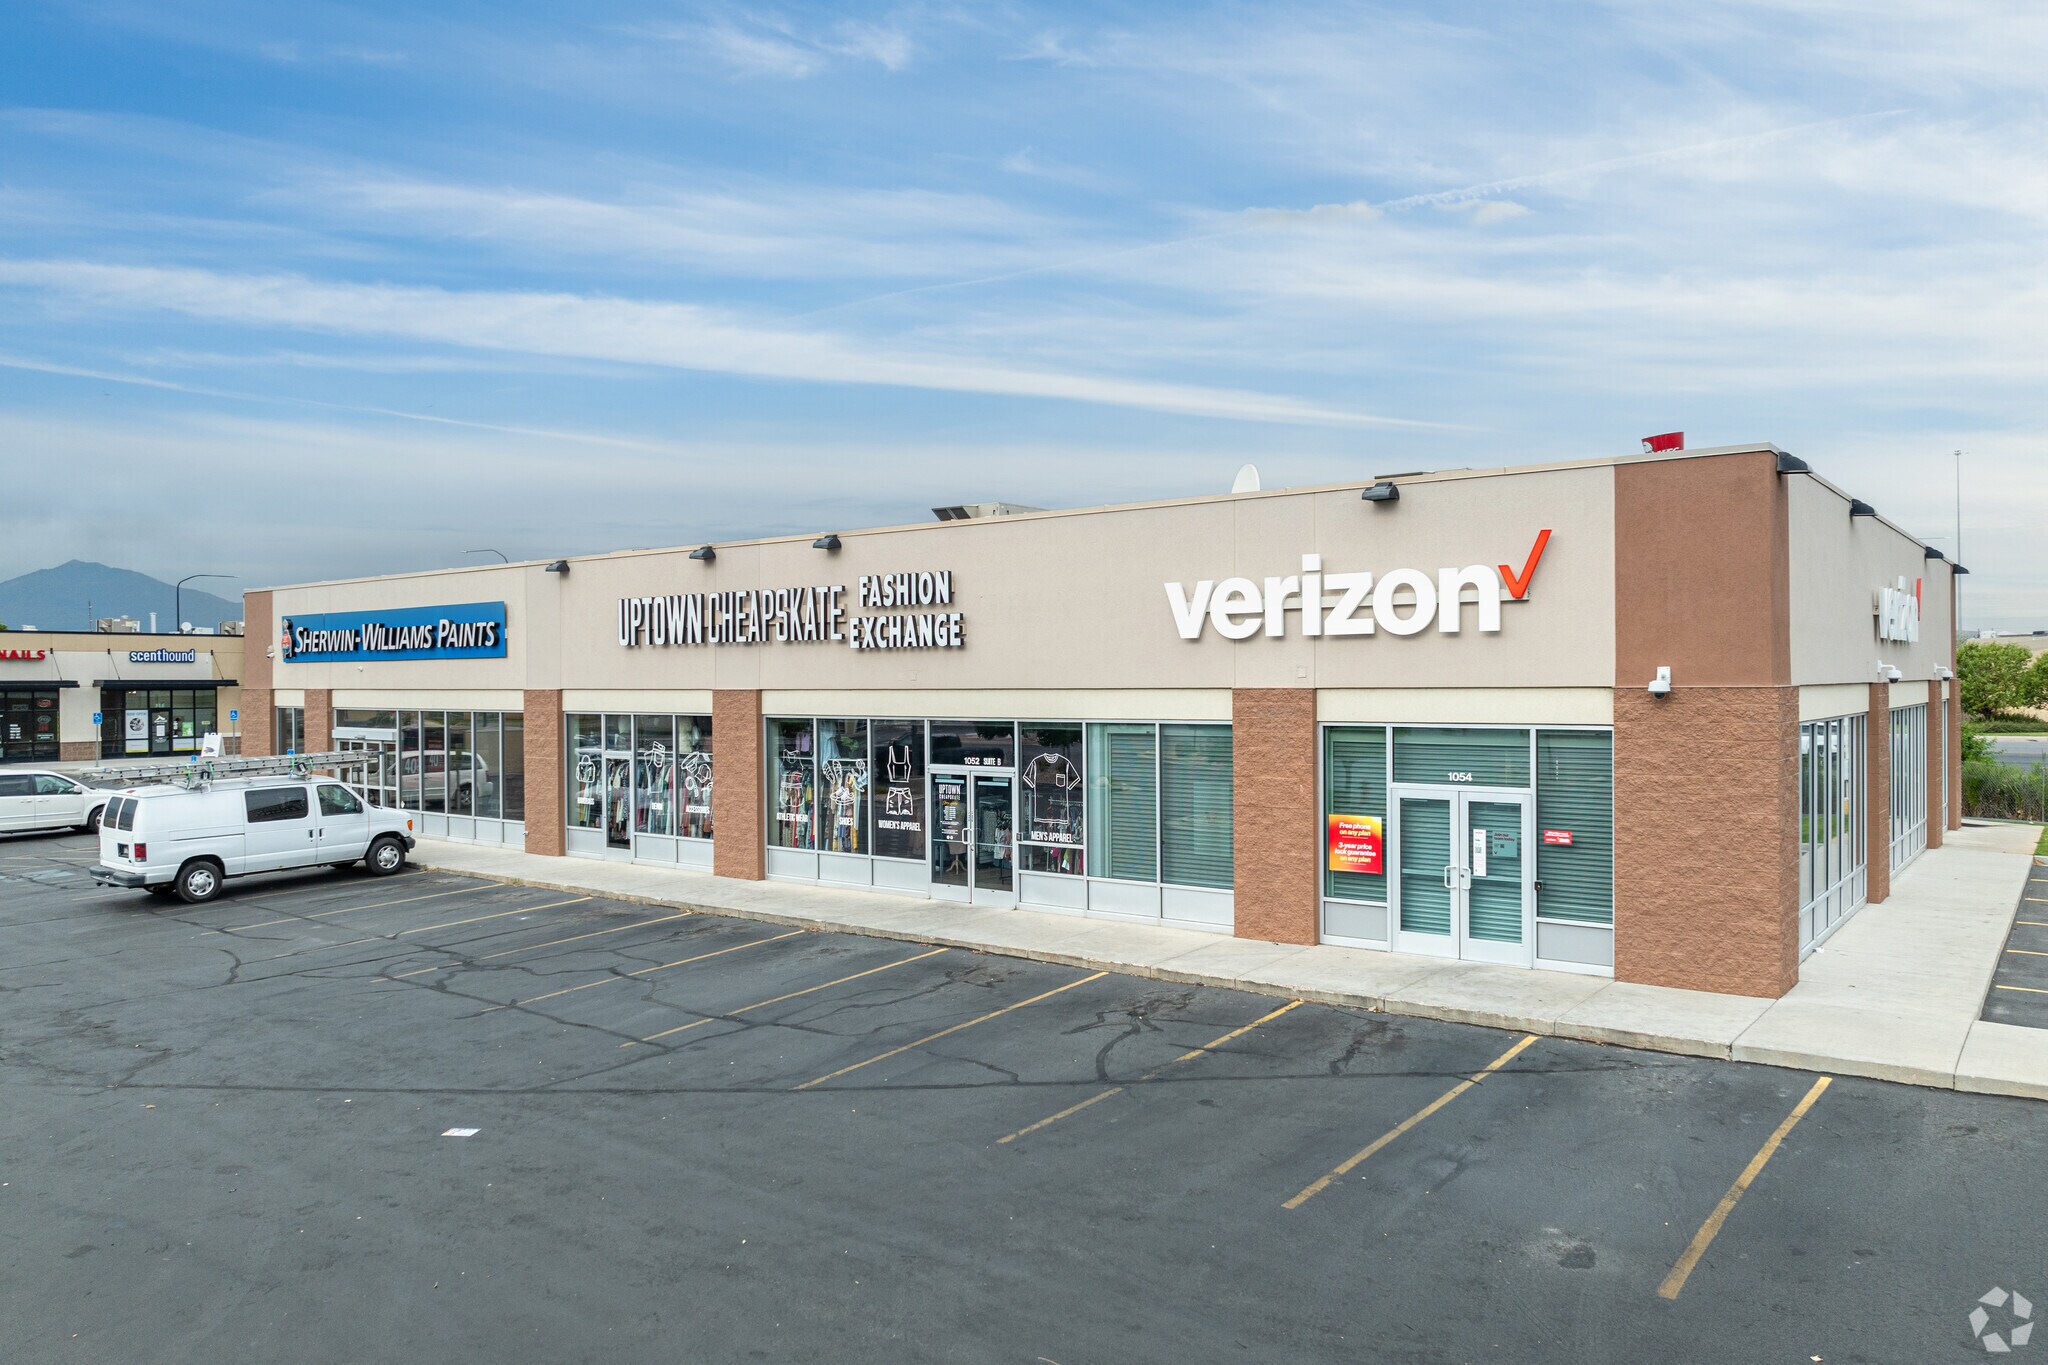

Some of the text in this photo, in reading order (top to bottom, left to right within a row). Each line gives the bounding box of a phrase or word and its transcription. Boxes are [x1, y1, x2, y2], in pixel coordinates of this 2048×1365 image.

[858, 571, 952, 608] FASHION
[1164, 553, 1501, 640] verizon
[618, 585, 846, 646] UPTOWN CHEAPSKATE
[850, 613, 965, 649] EXCHANGE
[129, 649, 195, 662] scenthound
[964, 757, 1002, 766] 1052 SUITE B
[1447, 771, 1473, 782] 1054
[938, 784, 961, 794] UPTOWN
[839, 816, 854, 825] SHOES
[878, 819, 921, 831] WOMEN'S APPAREL
[1031, 830, 1074, 843] MEN'S APPAREL
[1338, 842, 1373, 851] 3-year price
[1347, 849, 1377, 857] guarantee
